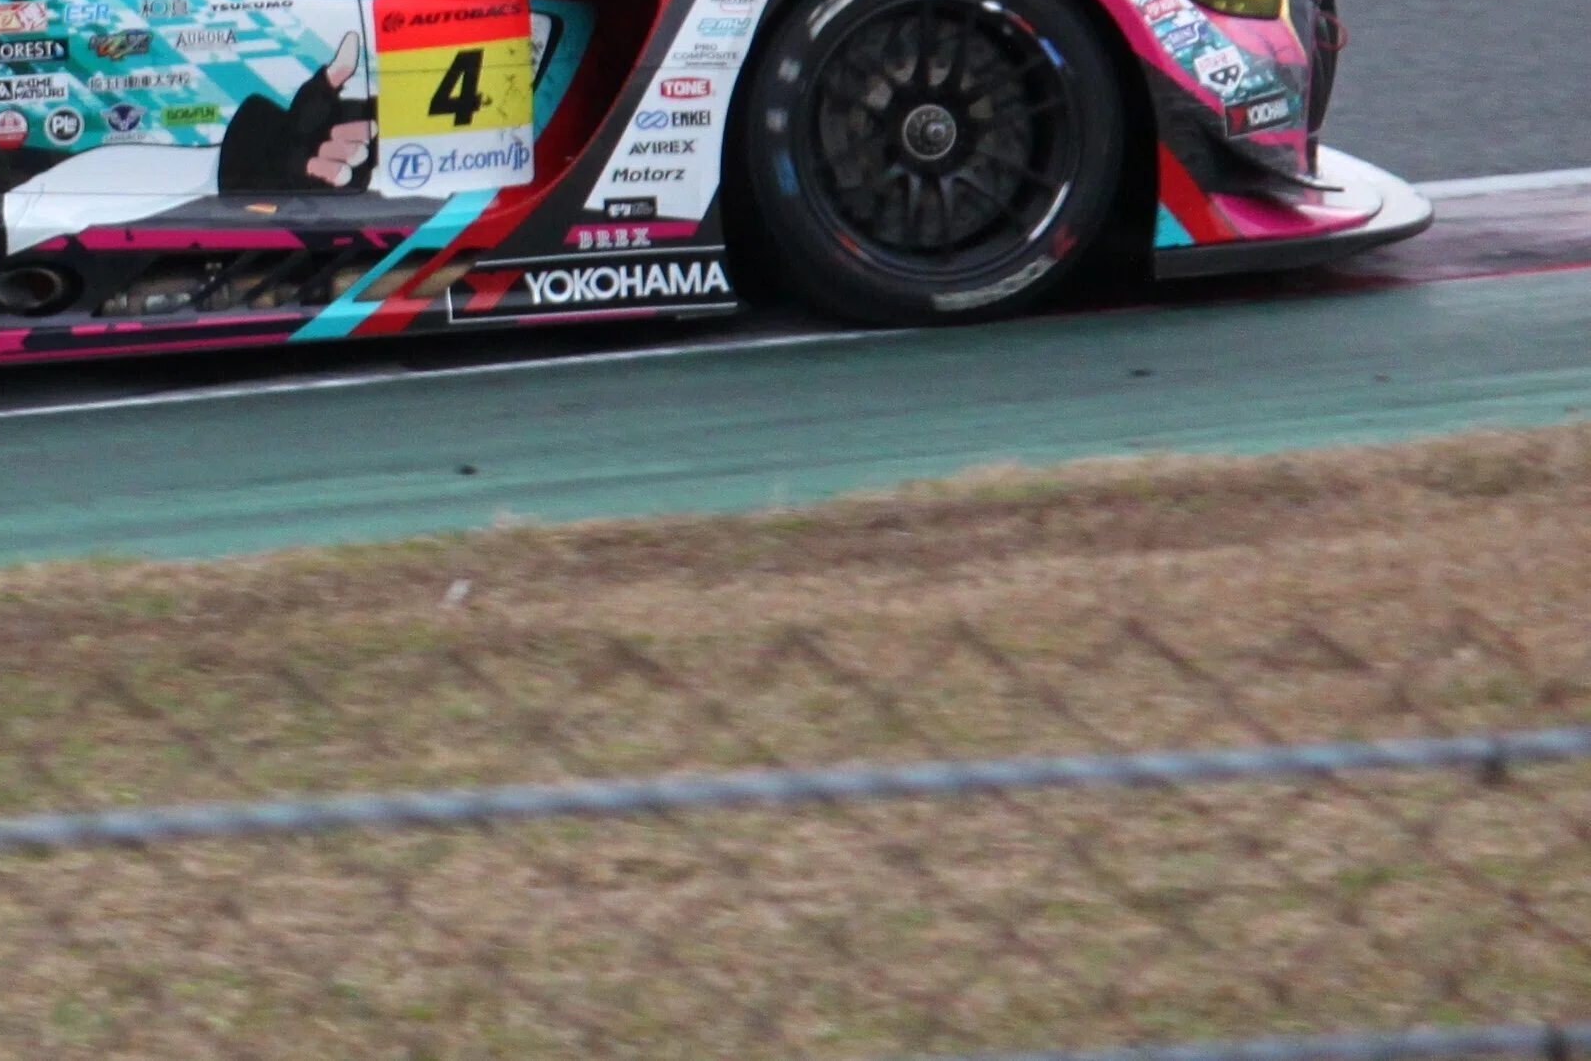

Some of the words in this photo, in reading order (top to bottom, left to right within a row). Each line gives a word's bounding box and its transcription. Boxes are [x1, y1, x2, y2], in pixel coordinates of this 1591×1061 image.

[211, 0, 294, 12] TSUKUMO
[409, 2, 521, 26] AUTOBACS
[427, 48, 484, 127] 4
[664, 80, 709, 96] TONE
[672, 110, 711, 127] ENKEI
[629, 140, 695, 155] AVIREX
[438, 143, 530, 172] zf.com/jp
[612, 167, 686, 183] Motorz
[524, 262, 730, 306] YOKOHAMA
